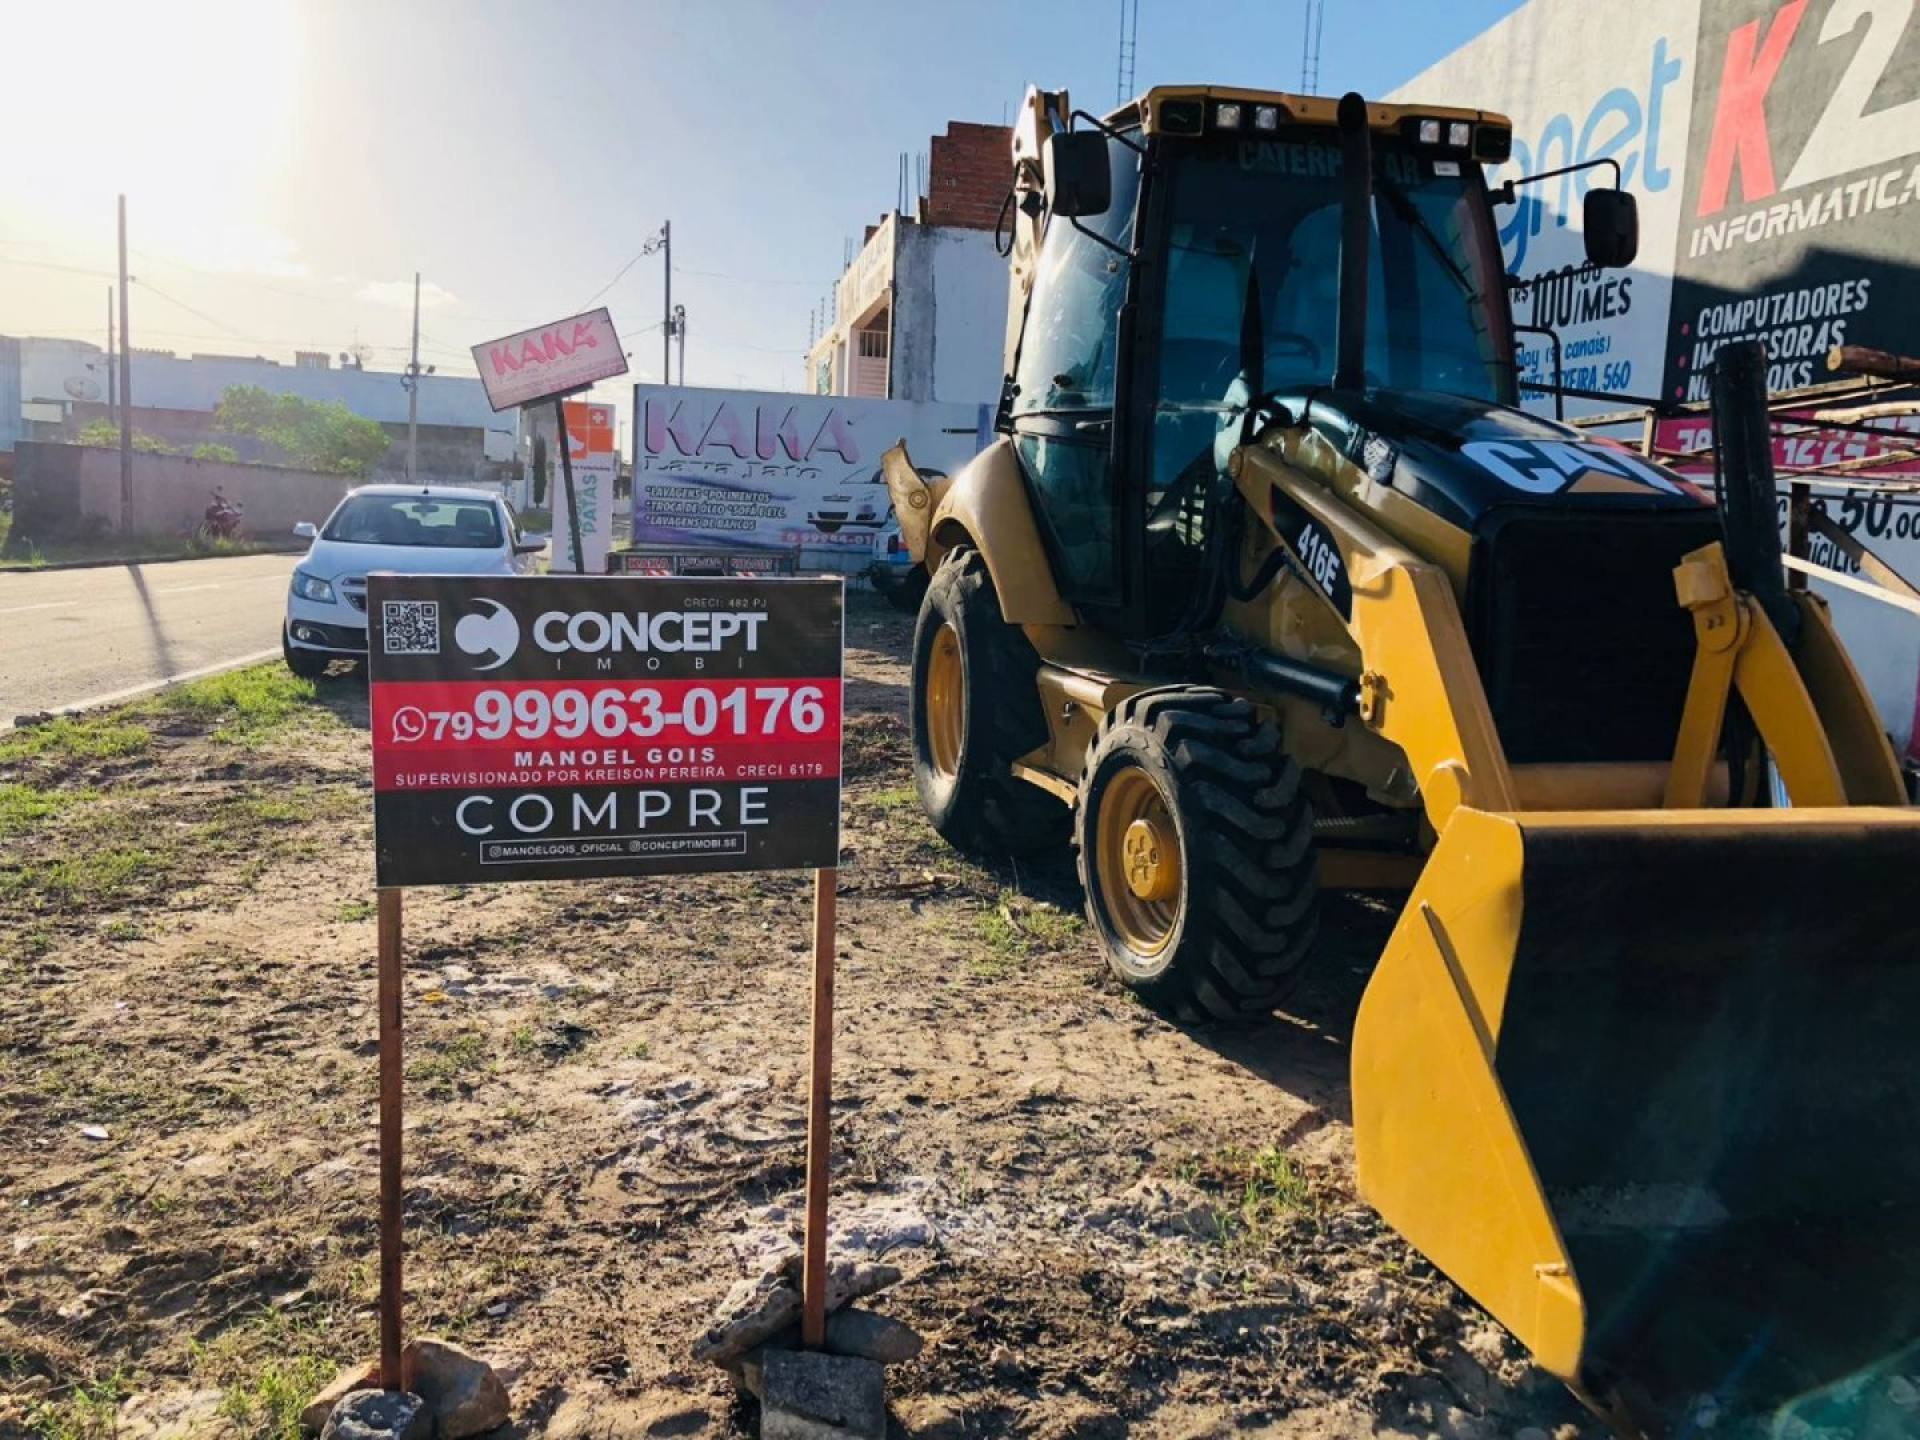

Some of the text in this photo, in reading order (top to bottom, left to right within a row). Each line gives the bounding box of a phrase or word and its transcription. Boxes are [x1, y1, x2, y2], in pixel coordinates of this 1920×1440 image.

[1697, 0, 1920, 217] K2
[1237, 141, 1420, 184] CATERPAR
[1697, 278, 1871, 337] COMPUTADORES
[1602, 360, 1632, 389] 560
[1460, 440, 1687, 495] CAT
[1298, 523, 1340, 597] 416E
[532, 611, 769, 653] CONCEPT
[395, 769, 541, 787] SUPERVISIONADO
[547, 768, 580, 782] POR
[585, 766, 654, 781] KREISON
[659, 765, 726, 779] PEREIRA
[736, 764, 783, 777] CRECI
[514, 746, 716, 767] MANOEL GOIS
[454, 786, 770, 835] COMPRE
